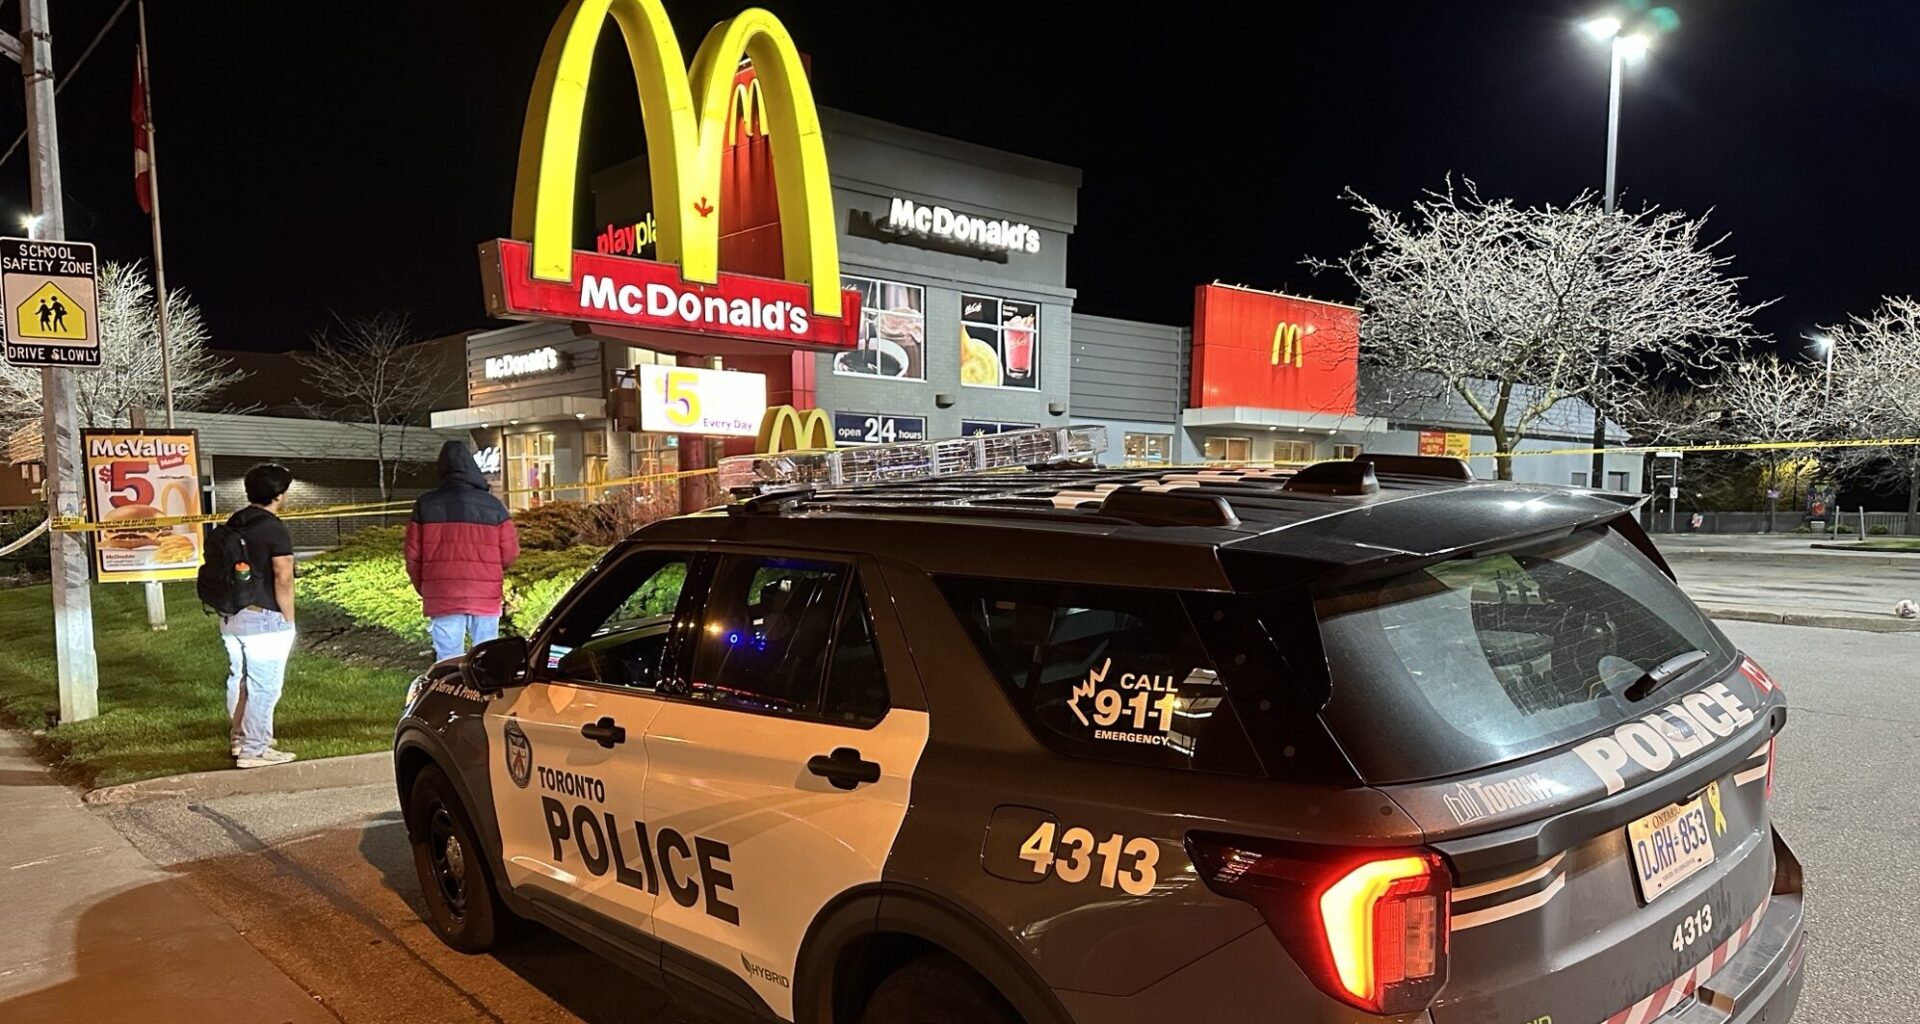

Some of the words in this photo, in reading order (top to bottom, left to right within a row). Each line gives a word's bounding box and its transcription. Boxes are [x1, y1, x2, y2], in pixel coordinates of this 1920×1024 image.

[597, 212, 657, 256] playpla
[889, 197, 1041, 253] McDonald's
[3, 257, 54, 272] SAFETY
[59, 261, 94, 275] ZONE
[19, 244, 76, 260] SCHOOL
[580, 275, 809, 335] McDonald's
[8, 346, 46, 360] DRIVE
[51, 348, 98, 362] SLOWLY
[485, 346, 558, 379] McDonald's
[703, 418, 731, 430] Every
[734, 419, 752, 431] Day
[838, 427, 862, 438] open
[864, 417, 897, 443] 24
[898, 429, 922, 440] hours
[91, 438, 190, 457] McValue
[1120, 673, 1178, 692] CALL
[1093, 689, 1175, 731] 9-1-1
[1094, 729, 1169, 746] EMERGENCY
[1572, 682, 1754, 796] POLICE
[538, 766, 605, 803] TORONTO
[1469, 773, 1558, 815] TORONT
[542, 796, 740, 926] POLICE
[1019, 822, 1160, 895] 4313
[1672, 904, 1713, 952] 4313
[751, 963, 789, 988] HYBRID
